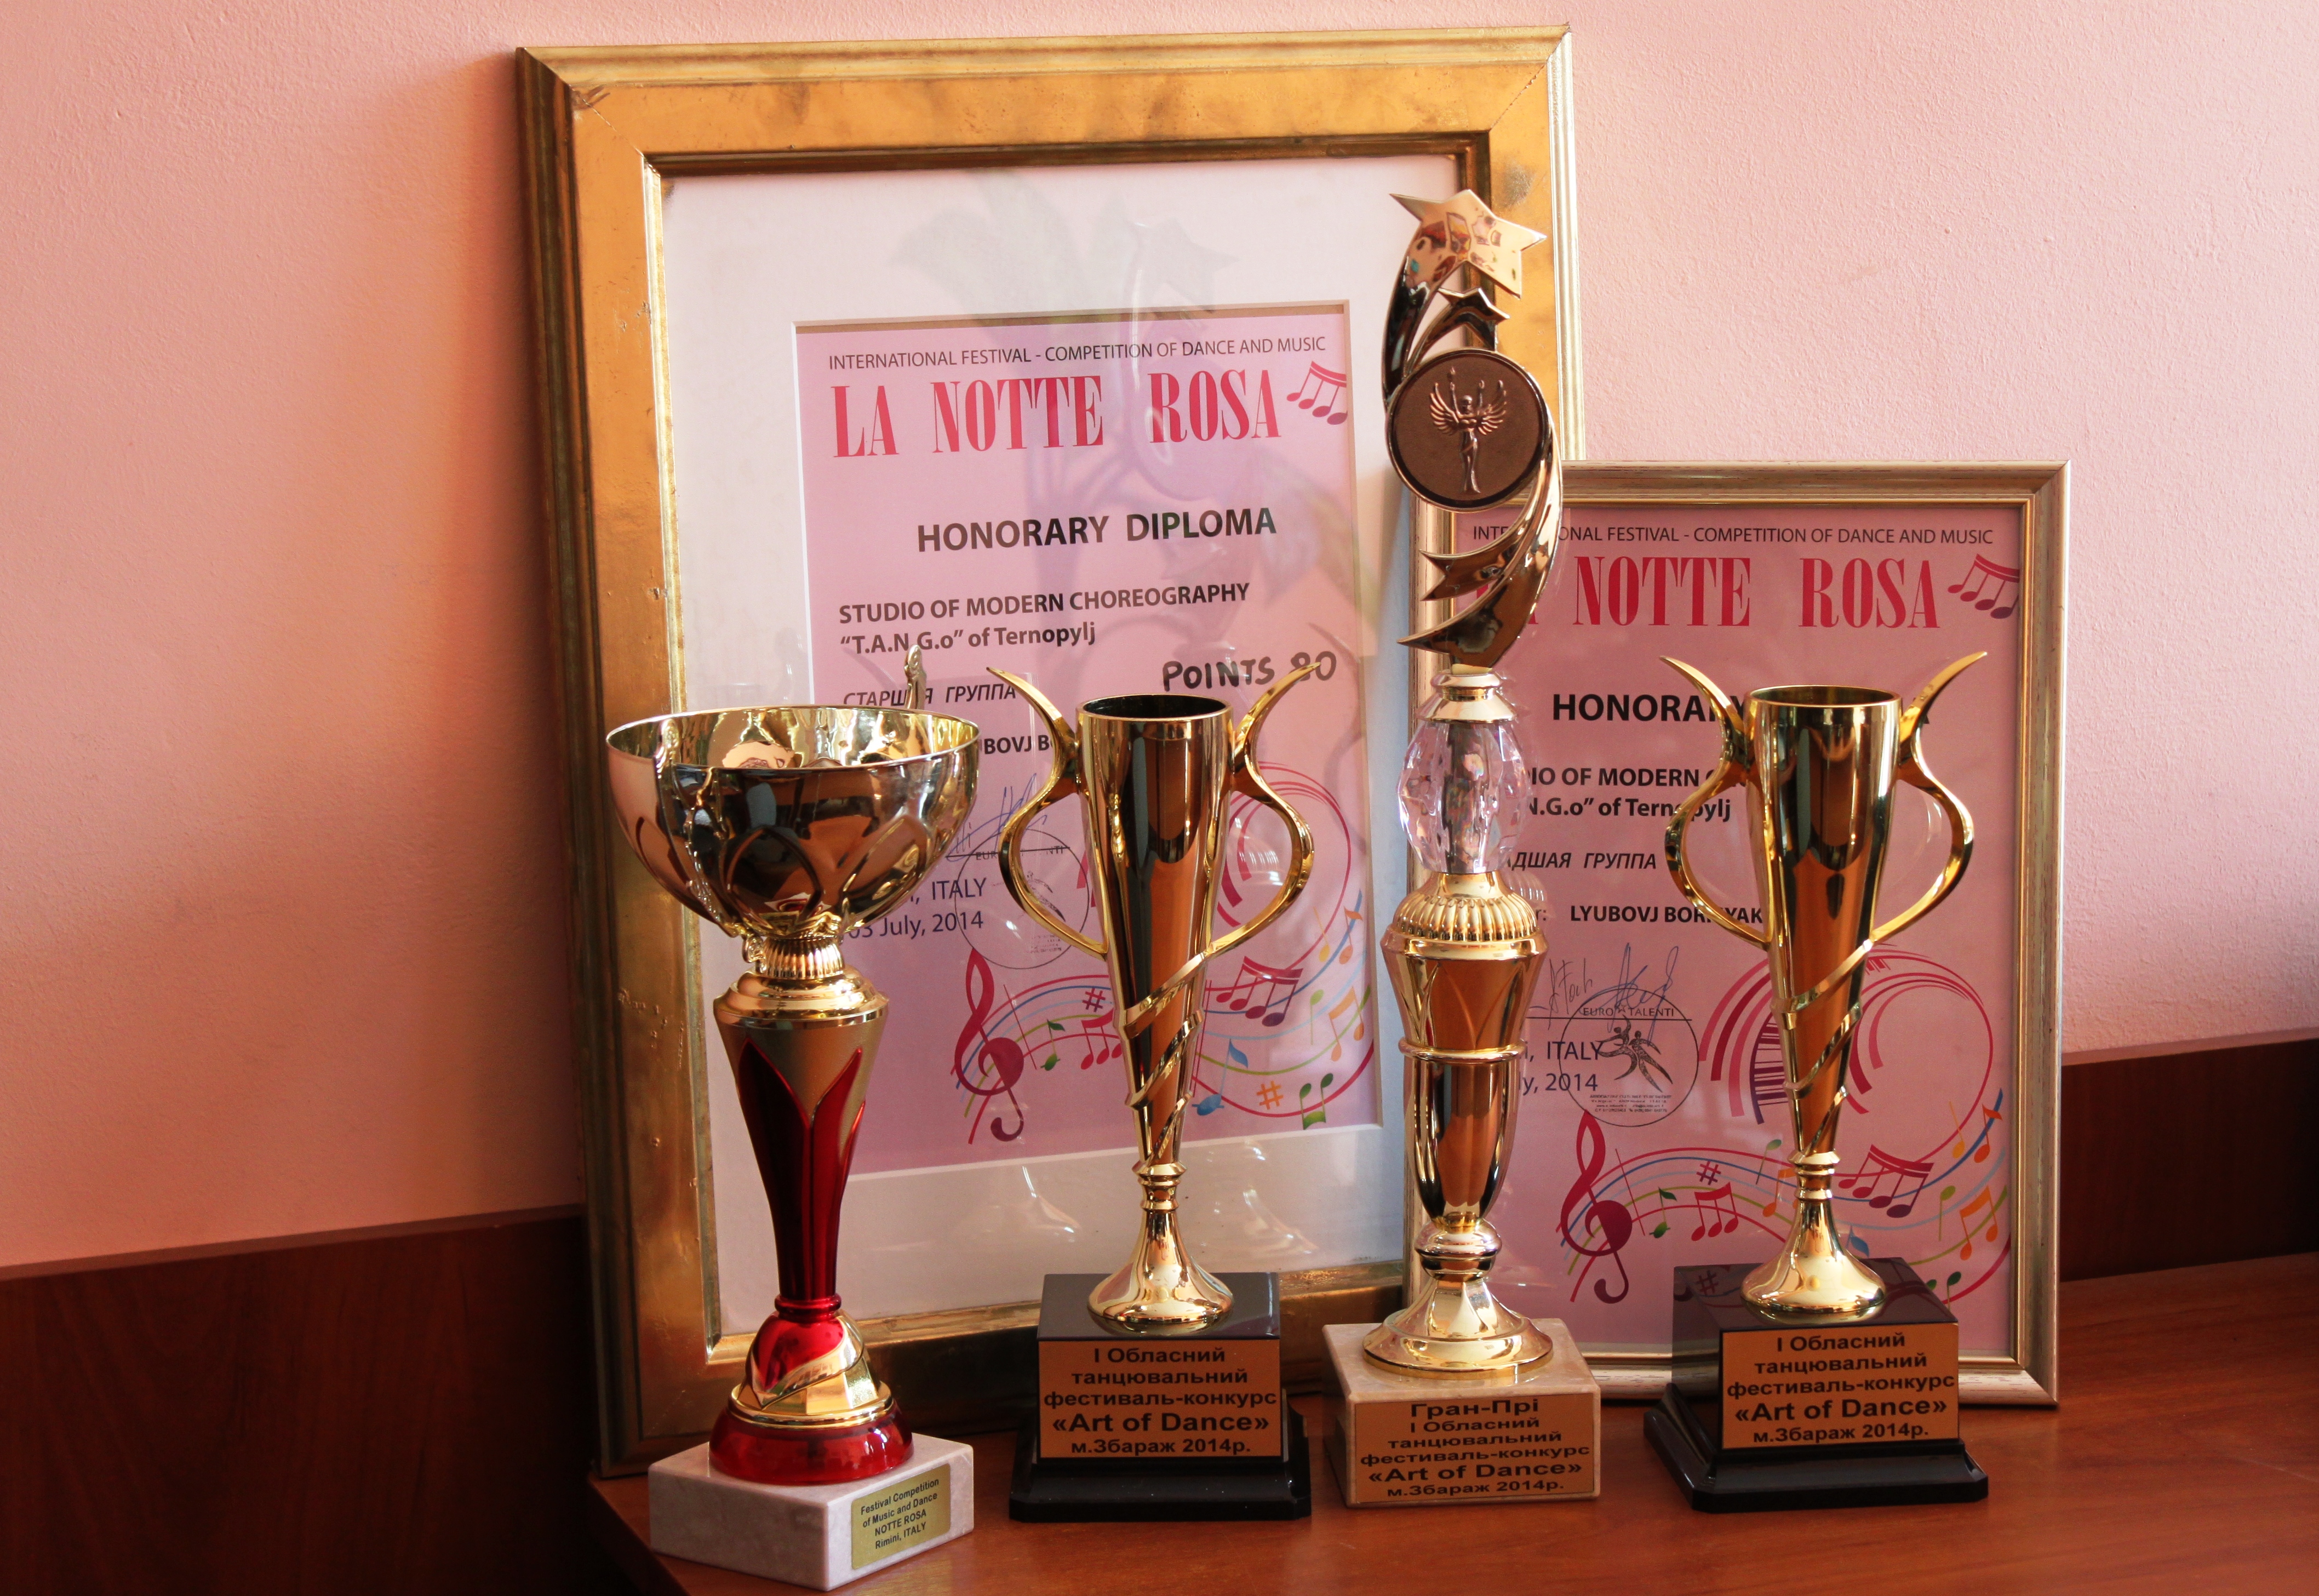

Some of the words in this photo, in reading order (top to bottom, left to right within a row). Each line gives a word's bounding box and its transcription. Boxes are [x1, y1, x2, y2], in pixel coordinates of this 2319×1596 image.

[829, 351, 957, 370] INTERNATIONAL
[961, 348, 1032, 364] FESTIVAL
[1045, 342, 1152, 362] COMPETITION
[1156, 342, 1177, 357] OF
[1182, 340, 1235, 356] DANCE
[1239, 339, 1273, 354] AND
[1278, 336, 1326, 352] MUSIC
[831, 385, 900, 458] LA
[930, 375, 1103, 453] NOTTE
[1147, 369, 1282, 444] ROSA
[917, 516, 1110, 552] HONORARY
[1126, 507, 1276, 542] DIPLOMA
[1607, 527, 1679, 541] FESTIVAL
[1694, 528, 1806, 542] COMPETITION
[1811, 529, 1833, 542] OF
[1838, 529, 1894, 543] DANCE
[1899, 529, 1936, 544] AND
[1940, 530, 1993, 544] MUSIC
[839, 600, 925, 624] STUDIO
[931, 599, 960, 619] OF
[966, 593, 1064, 617] MODERN
[1069, 582, 1250, 611] CHOREOGRAPHY
[1572, 556, 1750, 626] NOTTE
[1798, 558, 1940, 629] ROSA
[968, 627, 990, 647] of
[993, 621, 1096, 647] Ternopylj
[1290, 651, 1337, 682] 80
[843, 687, 934, 706] СТАРШЯ
[945, 683, 1016, 703] ГРУППА
[1562, 767, 1591, 786] OF
[1598, 768, 1699, 787] MODERN
[1598, 797, 1622, 816] of
[1625, 798, 1731, 821] Ternpylj
[1584, 853, 1657, 869] ГРУППА
[931, 878, 986, 900] ITALY
[879, 915, 926, 940] July,
[932, 911, 984, 933] 2014
[1571, 906, 1658, 923] LYUBOVJ
[1583, 1007, 1613, 1016] EURO
[1628, 1008, 1674, 1017] TALENTI
[1547, 1042, 1604, 1060] ITALY
[1545, 1073, 1598, 1092] 2014
[1790, 1332, 1905, 1351] Обласний
[1108, 1347, 1226, 1363] Обласний
[1754, 1353, 1927, 1374] танцювальний
[1071, 1369, 1248, 1387] танцювальний
[1727, 1374, 1955, 1400] фестиваль-конкурс
[1043, 1391, 1278, 1410] фестиваль-конкурс
[1411, 1398, 1539, 1420] Гран-Прі
[1735, 1401, 1795, 1422] «Art
[1803, 1399, 1834, 1420] of
[1842, 1398, 1948, 1418] Dance»
[1052, 1413, 1113, 1432] «Art
[1123, 1412, 1153, 1432] of
[1161, 1412, 1269, 1431] Dance»
[1423, 1417, 1539, 1433] Обласний
[1754, 1426, 1855, 1444] м.Збараж
[1863, 1422, 1928, 1440] 2014р.
[1072, 1439, 1176, 1456] м.Збараж
[1183, 1438, 1251, 1455] 2014р.
[1387, 1431, 1562, 1449] танцювальний
[1360, 1445, 1590, 1467] фестиваль-конкурс
[1369, 1467, 1429, 1483] «Art
[1438, 1465, 1467, 1480] of
[1475, 1462, 1582, 1478] Dance»
[861, 1496, 891, 1515] Festival
[892, 1478, 940, 1502] Competition
[1387, 1484, 1490, 1497] м.Збараж
[1496, 1479, 1564, 1492] 2014р.
[862, 1519, 872, 1528] of
[872, 1509, 895, 1525] Music
[897, 1503, 911, 1515] and
[913, 1492, 938, 1508] Dance
[874, 1519, 902, 1537] NOTTE
[904, 1508, 927, 1525] ROSA
[875, 1532, 902, 1549] Rimini,
[904, 1521, 926, 1537] ITALY
